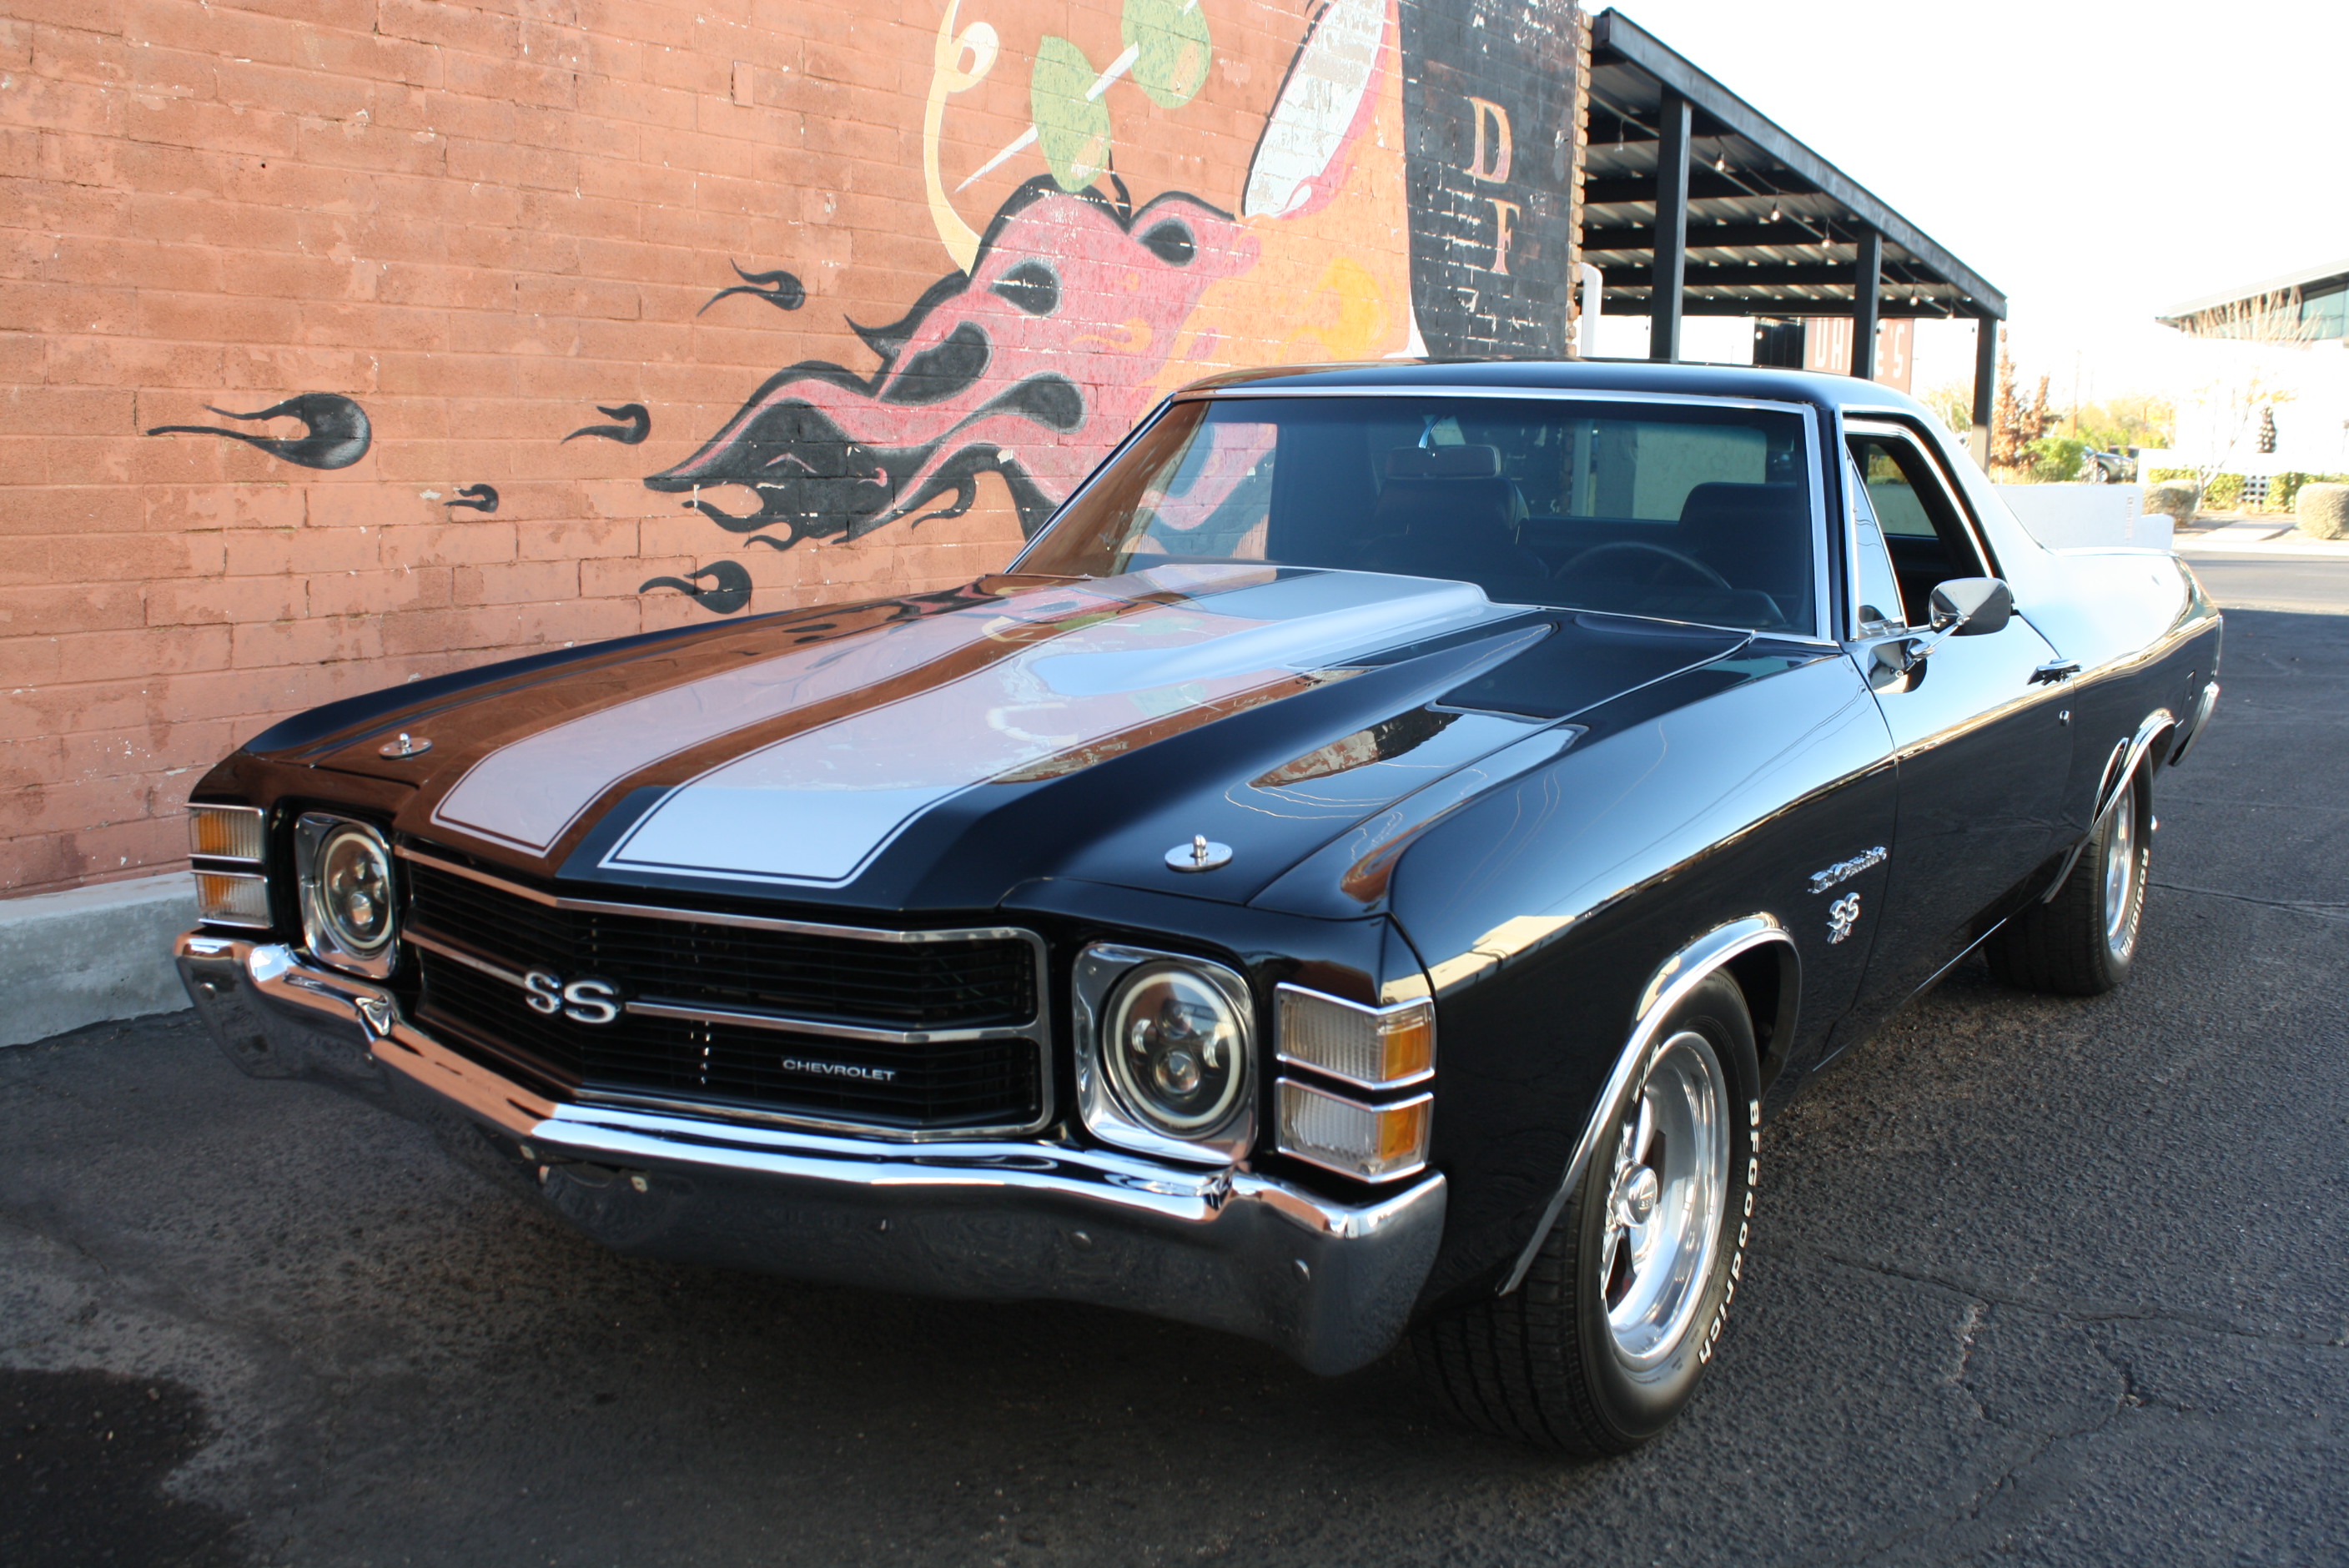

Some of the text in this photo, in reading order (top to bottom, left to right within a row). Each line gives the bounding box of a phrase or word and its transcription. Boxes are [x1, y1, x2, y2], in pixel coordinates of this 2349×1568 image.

[1463, 96, 1512, 184] D
[1826, 892, 1860, 930] SS
[2129, 847, 2150, 935] Radial
[524, 969, 621, 1025] SS
[782, 1058, 896, 1081] CHEVROLET
[1698, 1098, 1761, 1365] BFGoodrich
